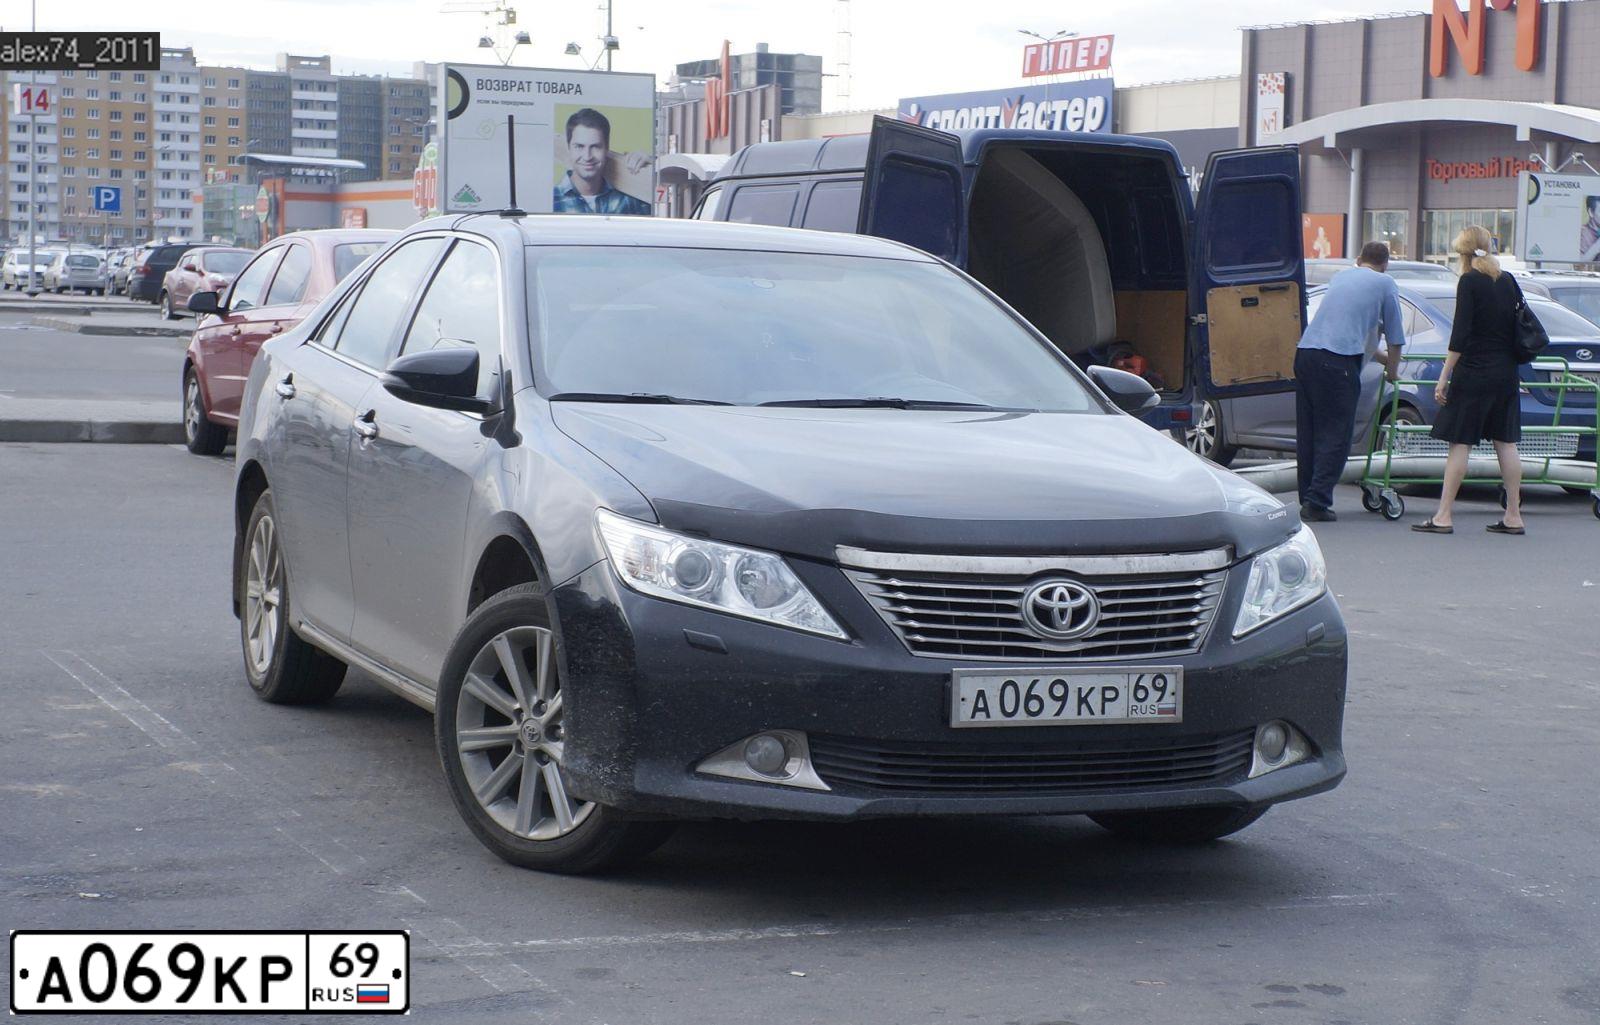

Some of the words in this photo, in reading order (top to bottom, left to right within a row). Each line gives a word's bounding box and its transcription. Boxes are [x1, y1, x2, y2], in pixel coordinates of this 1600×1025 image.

[1024, 37, 1111, 74] ГИПЕР
[476, 79, 532, 92] ВОЗВРАТ
[536, 81, 582, 95] ТОВАРА
[22, 88, 49, 111] 14
[1426, 157, 1500, 184] Торговый
[1543, 180, 1582, 190] УСТАНОВКА
[100, 188, 116, 209] P
[656, 189, 665, 203] 7
[970, 678, 1120, 719] А069КР
[1132, 673, 1168, 703] 69
[1130, 705, 1156, 716] RUS
